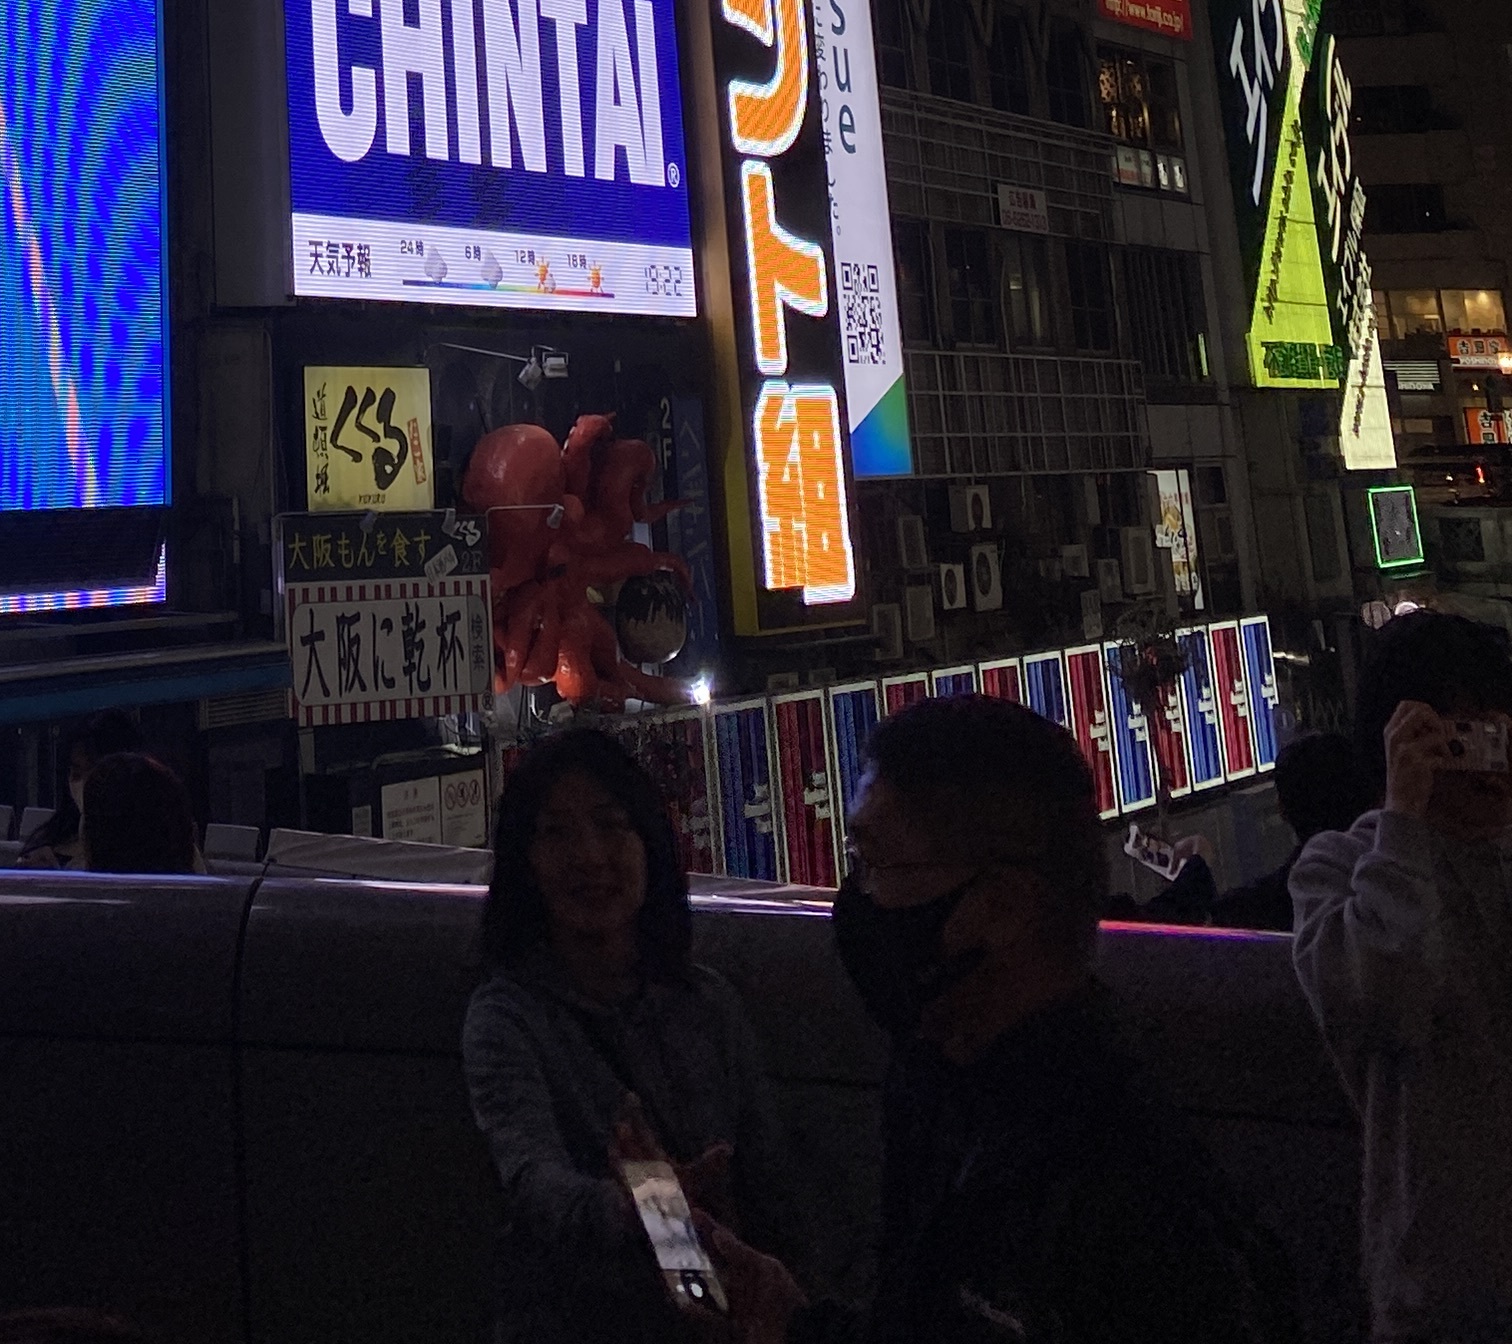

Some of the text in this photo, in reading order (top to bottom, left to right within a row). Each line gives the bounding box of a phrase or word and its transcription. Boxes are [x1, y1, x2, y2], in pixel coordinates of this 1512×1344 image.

[308, 240, 373, 279] 天気予報
[329, 385, 409, 490] くくる
[288, 528, 432, 570] 大阪もんを食す
[300, 601, 464, 700] 大阪に乾杯
